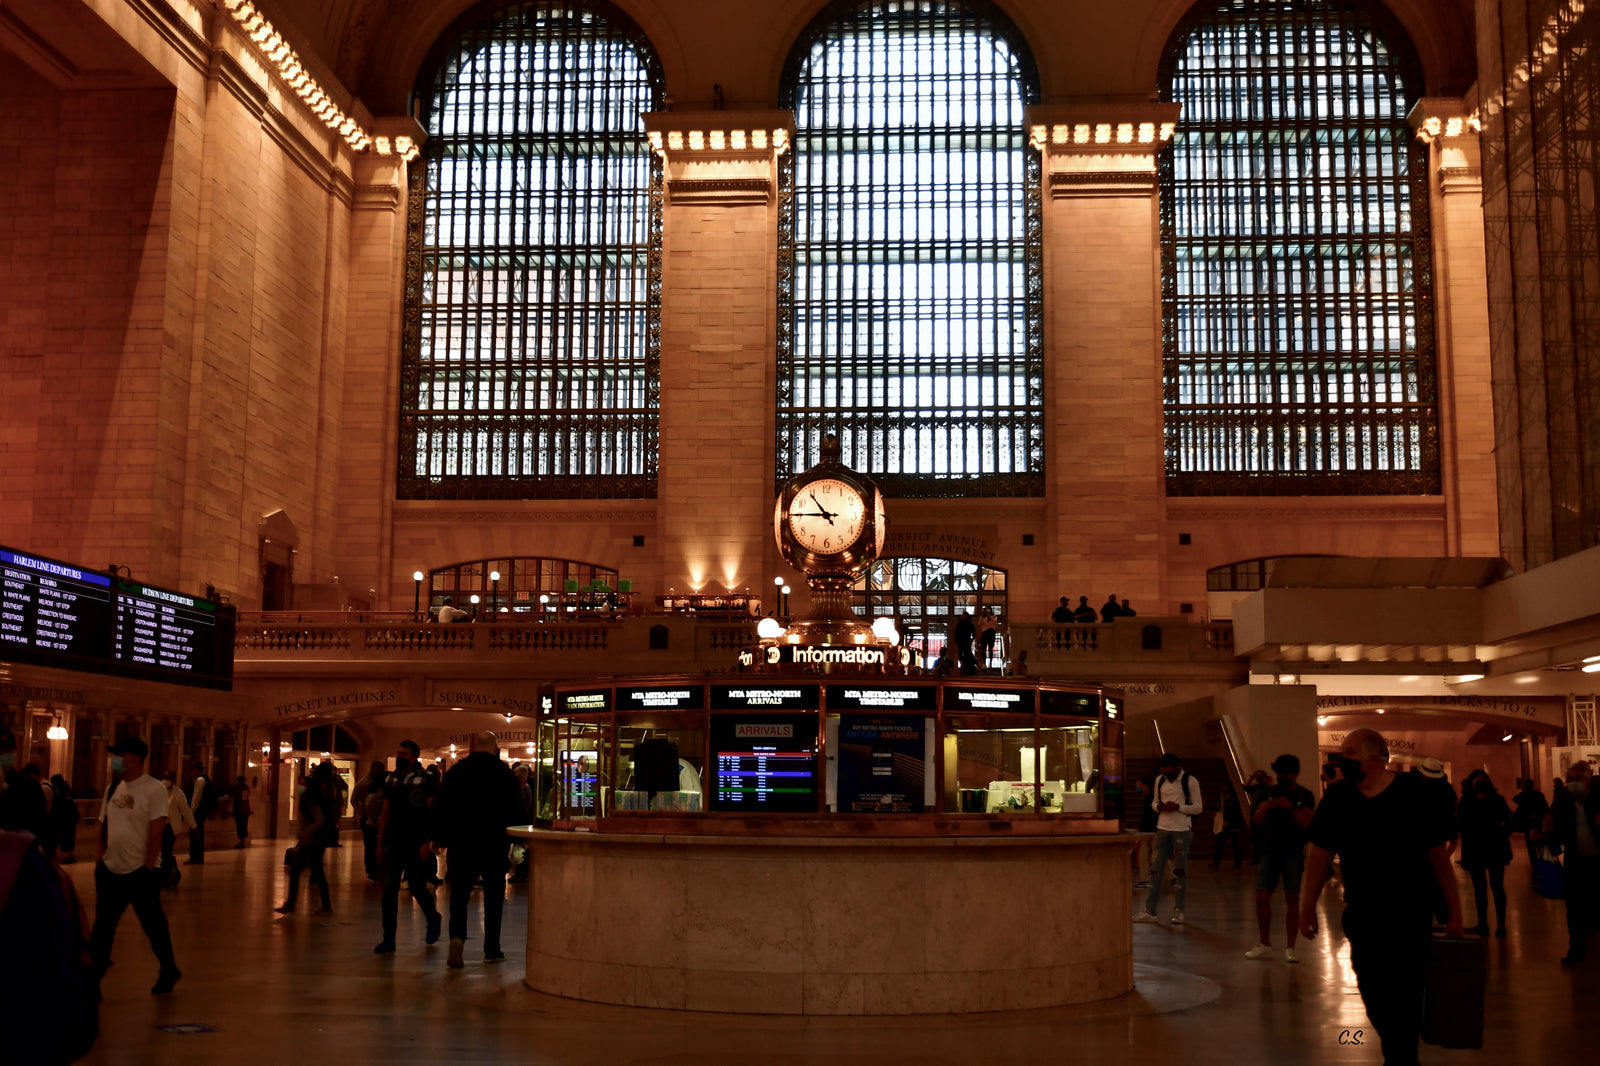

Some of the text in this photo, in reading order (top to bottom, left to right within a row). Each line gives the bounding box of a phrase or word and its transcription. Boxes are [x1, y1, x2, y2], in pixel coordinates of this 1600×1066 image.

[822, 484, 831, 494] 12
[839, 487, 843, 497] 1
[799, 499, 806, 508] 10
[848, 495, 854, 506] 2
[850, 511, 857, 521] 3
[800, 526, 806, 536] 8
[848, 525, 854, 535] 4
[810, 534, 816, 545] 7
[823, 537, 830, 549] 6
[837, 535, 844, 546] 5
[939, 533, 986, 548] AVENUE
[37, 561, 50, 572] LINE
[50, 563, 82, 580] DEPARTURES
[792, 645, 885, 664] Information
[1130, 685, 1177, 694] BALCONY
[274, 691, 396, 716] TICKET MACHINES
[439, 691, 491, 705] SUBWAY
[500, 697, 534, 712] 42ND
[746, 697, 783, 705] ARRIVALS
[1501, 699, 1520, 713] TO
[1523, 704, 1537, 717] 42
[496, 731, 535, 741] SHUTTL
[738, 725, 791, 736] ARRIVALS
[1383, 738, 1415, 750] ROOM
